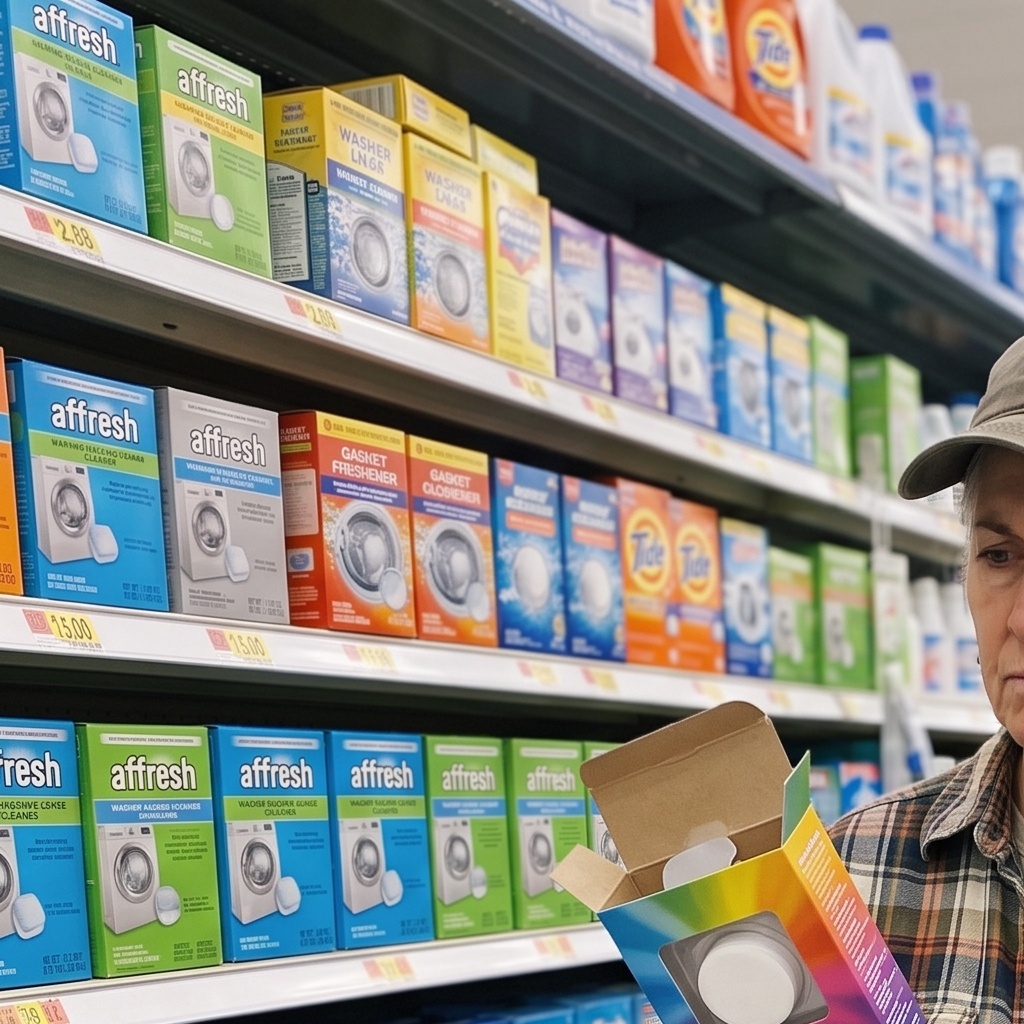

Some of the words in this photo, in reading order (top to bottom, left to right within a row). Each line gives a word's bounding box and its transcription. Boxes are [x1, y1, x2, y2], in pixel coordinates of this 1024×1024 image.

[33, 4, 119, 66] affresh
[177, 68, 250, 122] affresh
[339, 125, 391, 162] WASHER
[51, 398, 140, 444] affresh
[190, 424, 267, 467] affresh
[341, 447, 388, 468] GASKET
[630, 531, 665, 571] Tide
[111, 755, 198, 791] affresh
[240, 756, 314, 789] affresh
[351, 759, 414, 789] affresh
[442, 763, 496, 792] affresh
[526, 765, 577, 793] affresh
